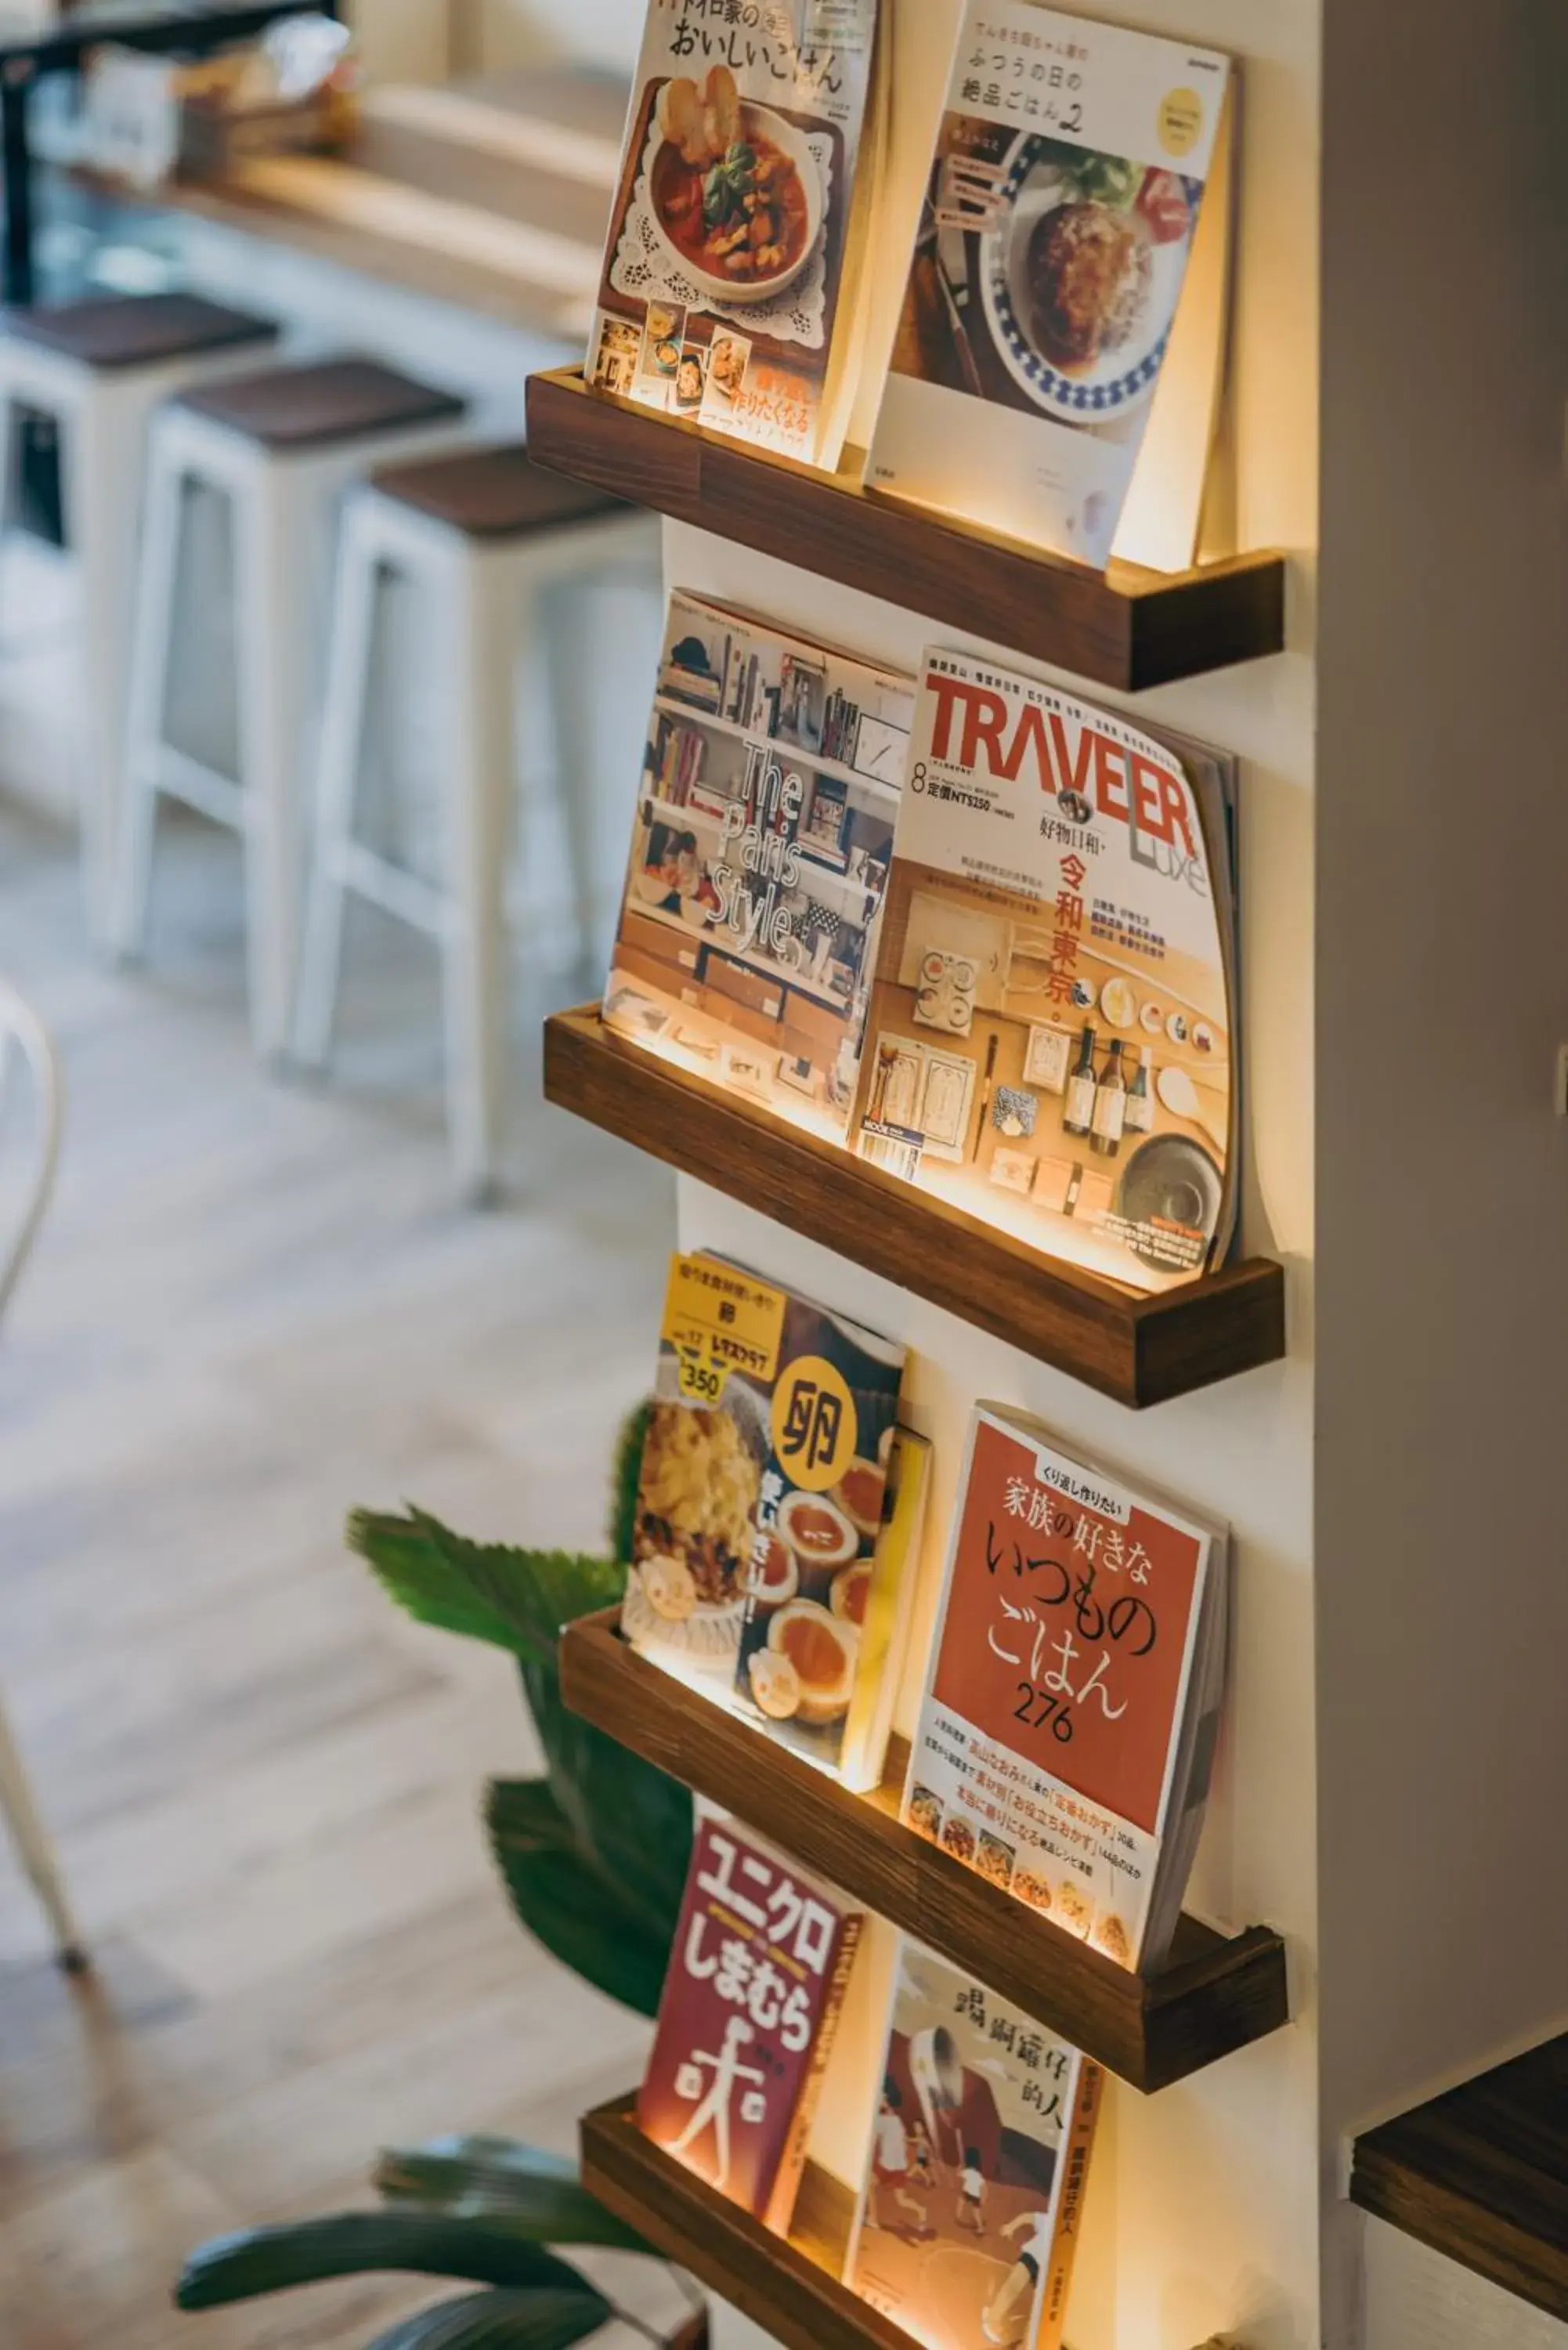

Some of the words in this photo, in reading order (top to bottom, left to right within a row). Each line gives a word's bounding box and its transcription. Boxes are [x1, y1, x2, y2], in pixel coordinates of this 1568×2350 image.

[670, 17, 843, 93] おいしいごはん
[968, 47, 1082, 92] ふつうの日の
[742, 739, 804, 820] The
[912, 761, 927, 794] 8
[717, 801, 803, 888] Paris
[705, 864, 793, 953] Style
[782, 1379, 844, 1470] 卵
[1003, 1477, 1153, 1585] 家族の好きな
[1043, 1466, 1122, 1515] くり返し作りたい
[987, 1520, 1157, 1656] いつもの
[988, 1593, 1129, 1719] ごはん
[1013, 1682, 1073, 1743] 276
[697, 1834, 836, 1976] ユニクロ
[684, 1911, 811, 2052] しまむら
[1021, 2079, 1064, 2130] 的人
